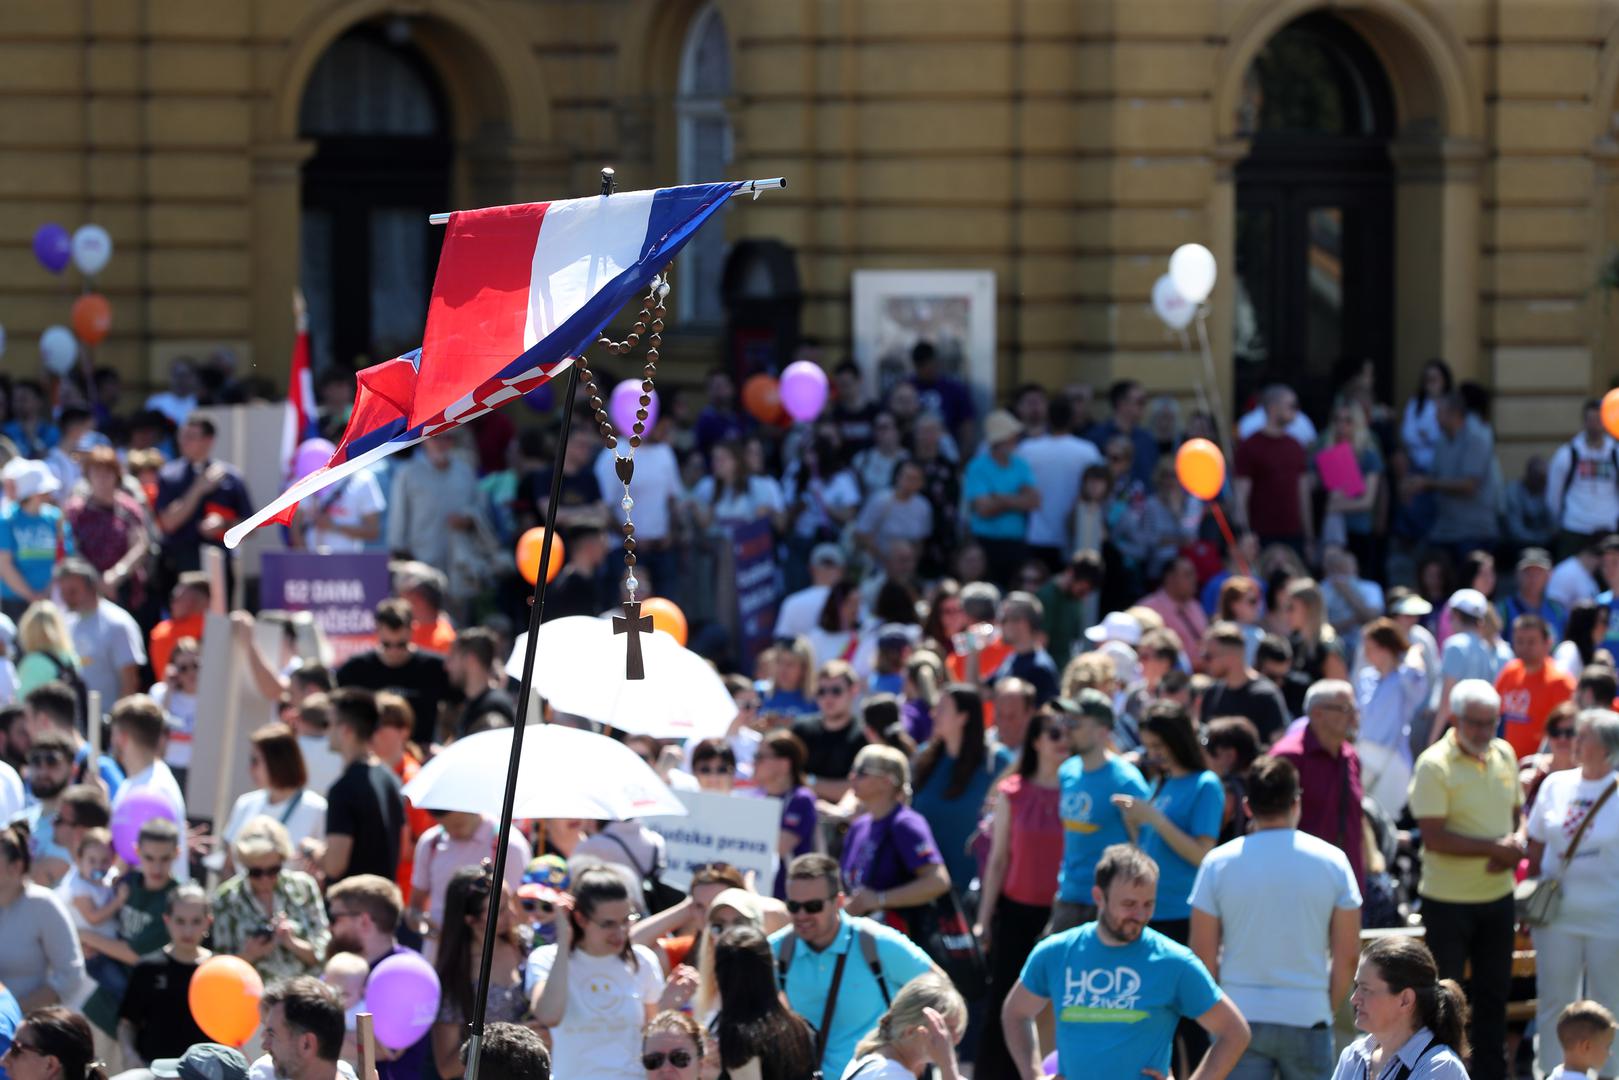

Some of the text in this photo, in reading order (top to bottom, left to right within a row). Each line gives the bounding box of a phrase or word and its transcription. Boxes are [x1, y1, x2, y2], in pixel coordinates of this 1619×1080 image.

[311, 579, 365, 604] DANA
[716, 834, 767, 854] prava
[1065, 967, 1141, 997] HOD
